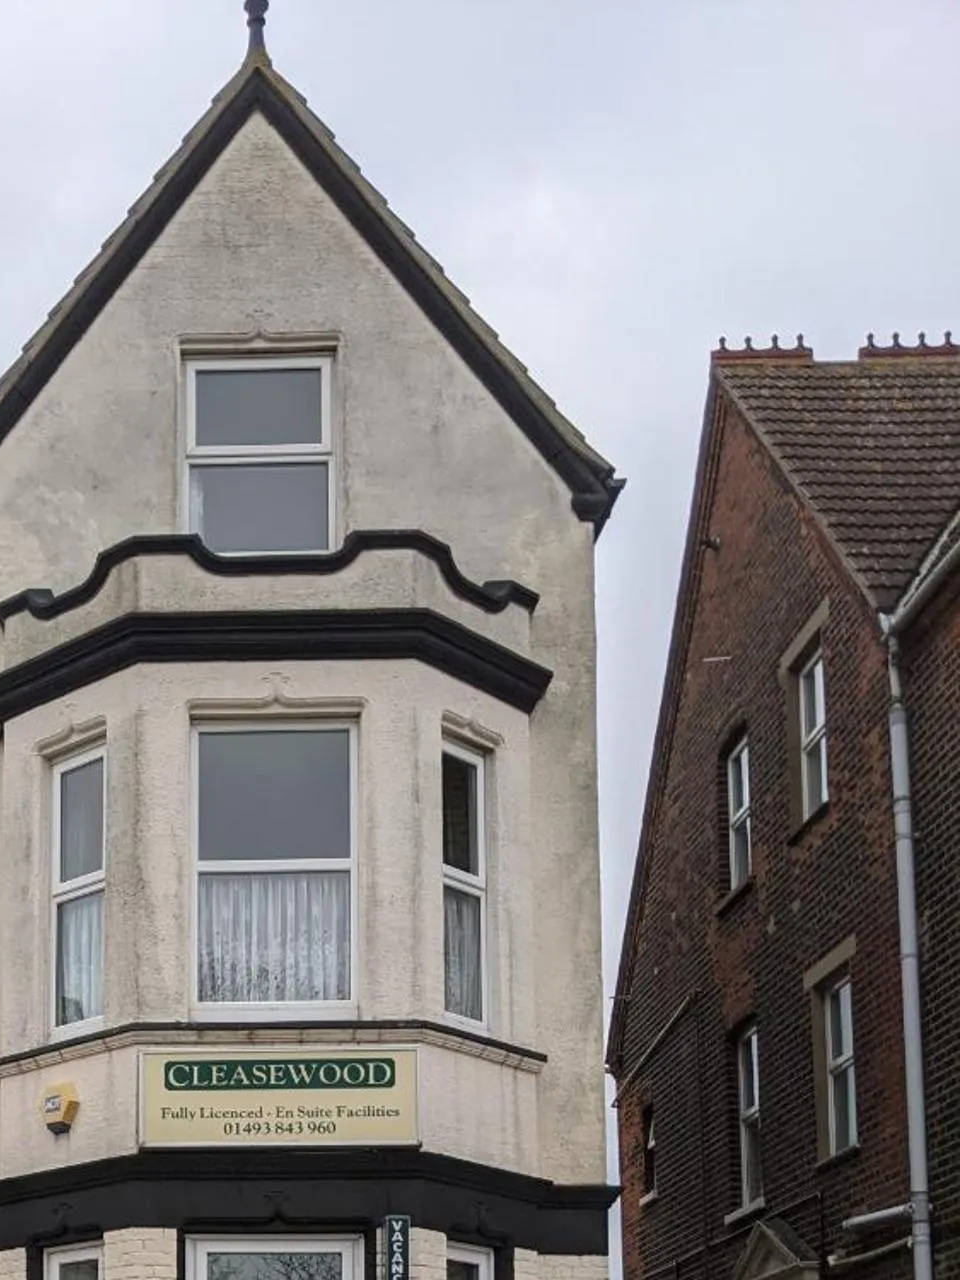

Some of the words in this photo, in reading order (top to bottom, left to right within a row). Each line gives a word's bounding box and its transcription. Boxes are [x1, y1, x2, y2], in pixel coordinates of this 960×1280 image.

[167, 1061, 392, 1087] CLEASEWOOD
[161, 1106, 196, 1120] Fully
[200, 1105, 263, 1119] Licenced
[276, 1105, 294, 1119] En
[297, 1105, 332, 1119] Suite
[336, 1104, 400, 1118] Facilities
[223, 1122, 271, 1135] 01493
[275, 1121, 303, 1134] 843
[307, 1120, 337, 1134] 960
